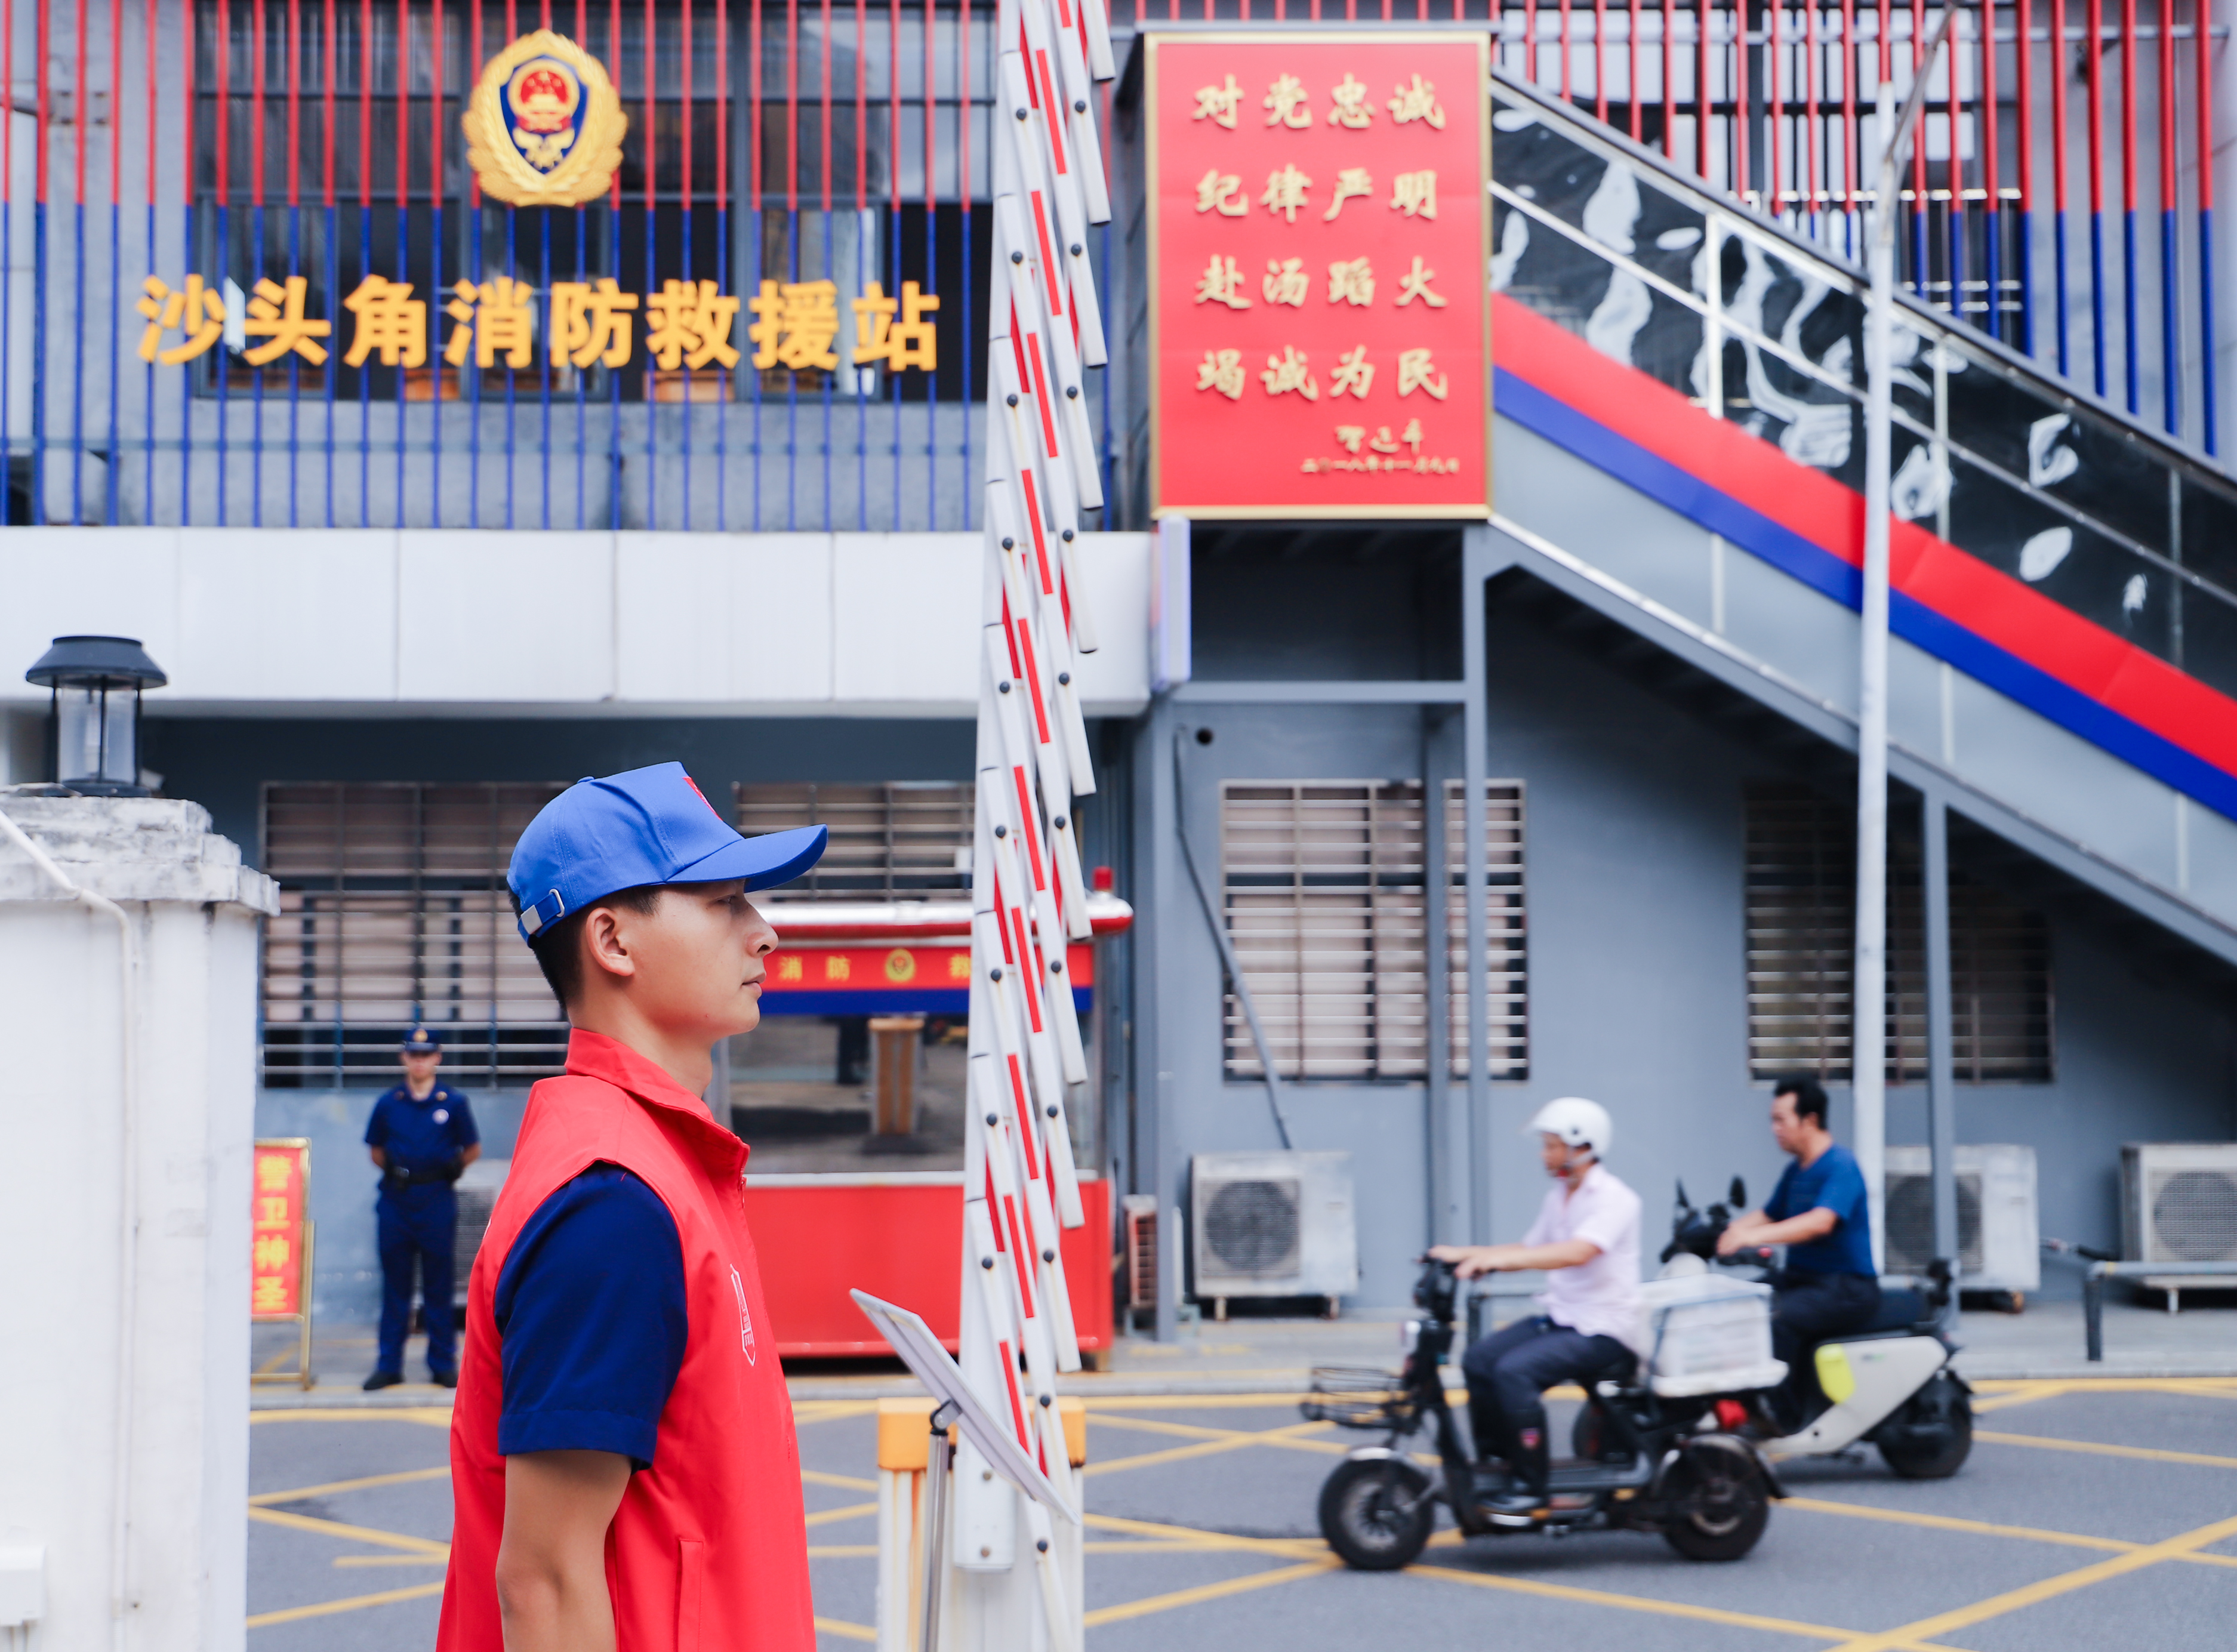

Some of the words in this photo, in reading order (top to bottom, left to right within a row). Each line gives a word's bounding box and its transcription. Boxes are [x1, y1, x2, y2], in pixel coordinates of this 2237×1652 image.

[1191, 72, 1446, 130] 对党忠诚
[1195, 163, 1439, 223] 纪律严明
[1195, 254, 1447, 310] 赴汤蹈火
[135, 273, 940, 371] 沙头角消防救援站
[1195, 344, 1449, 401] 竭诚为民
